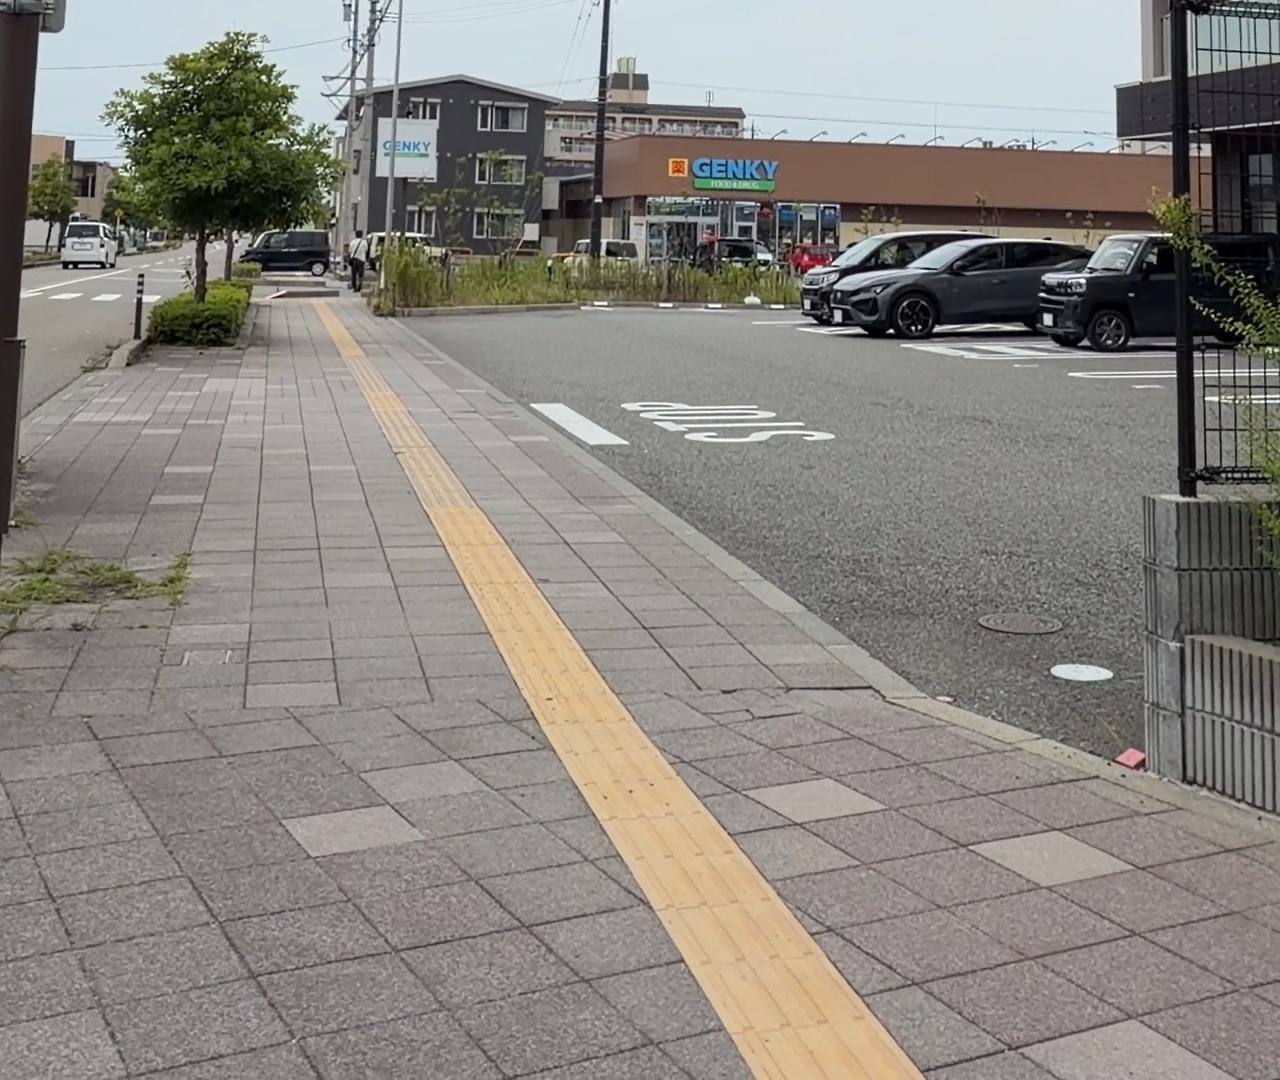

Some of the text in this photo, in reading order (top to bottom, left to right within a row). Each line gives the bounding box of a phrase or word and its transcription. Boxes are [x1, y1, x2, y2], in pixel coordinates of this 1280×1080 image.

[383, 140, 431, 152] GENKY
[692, 158, 779, 180] GENKY
[620, 401, 836, 443] STOP
